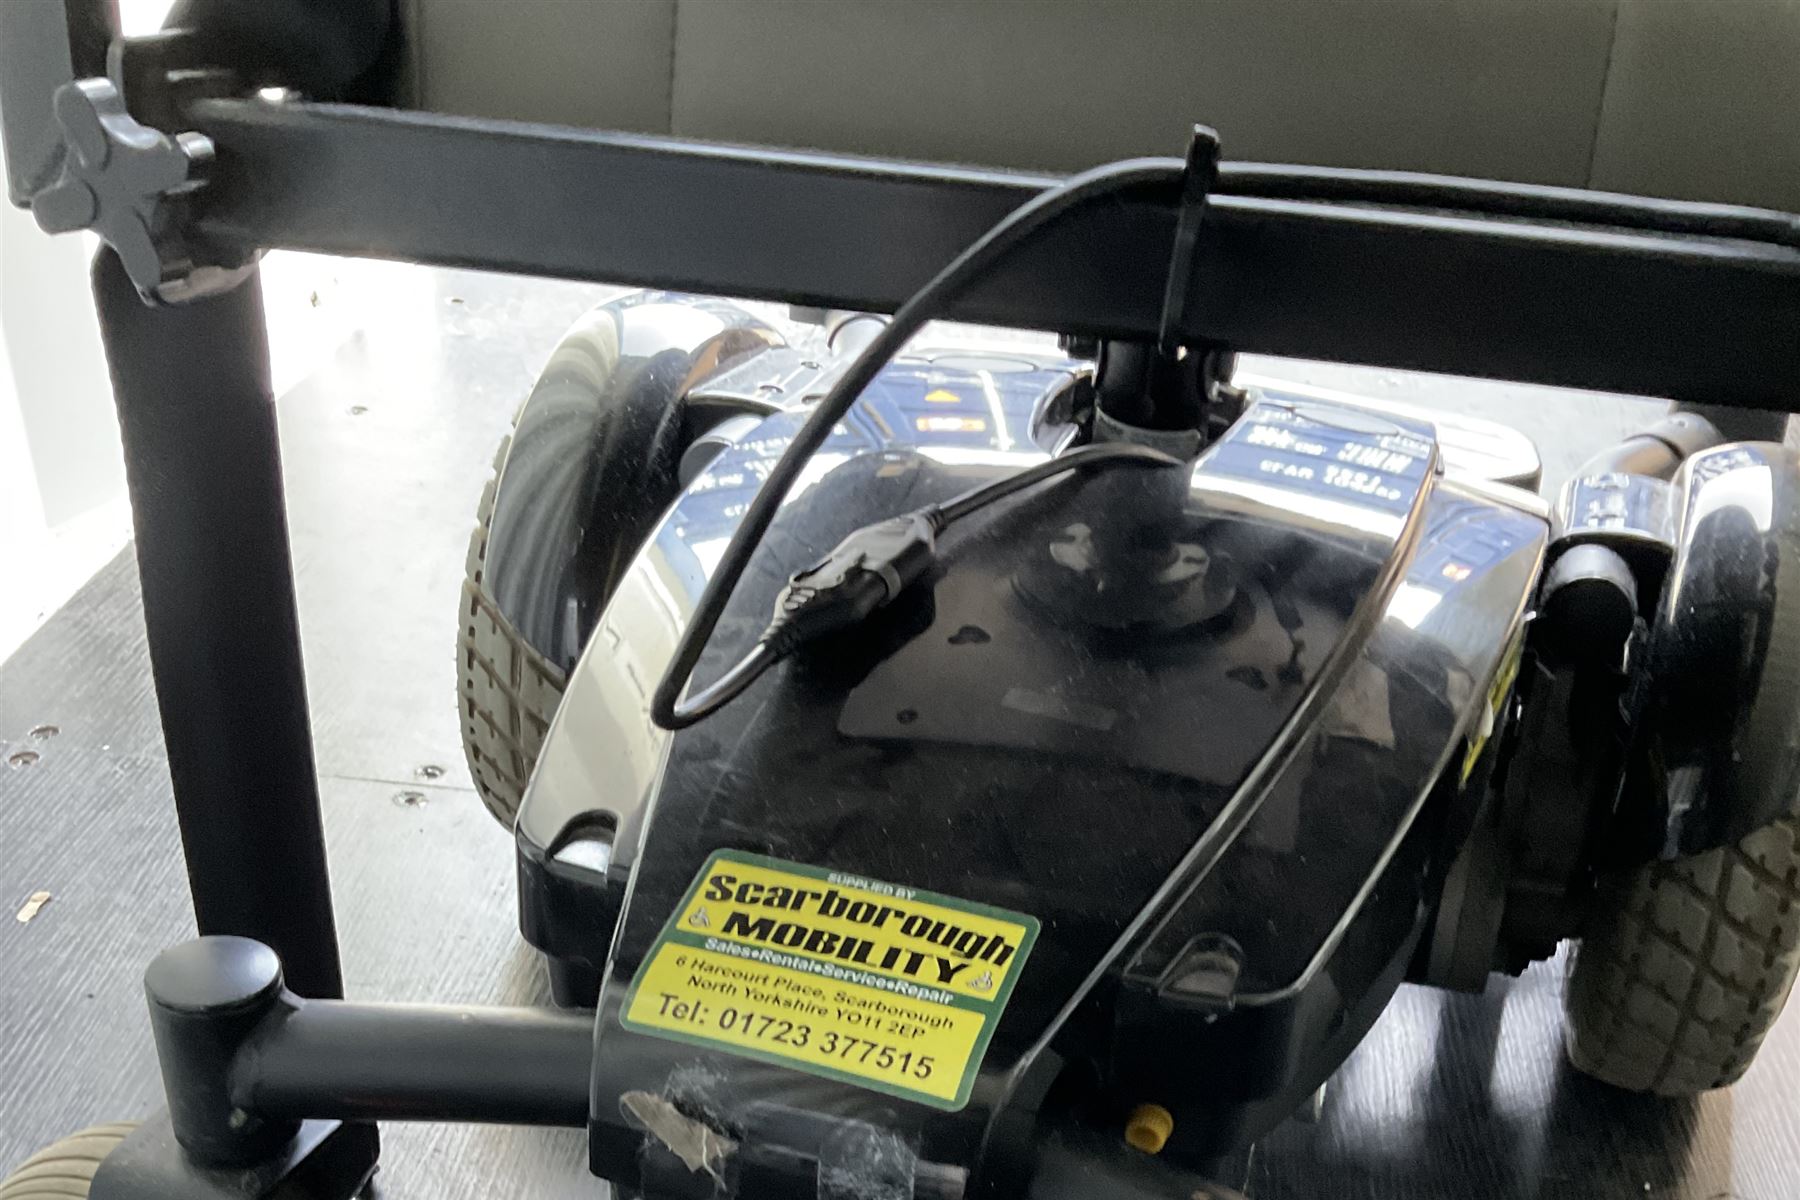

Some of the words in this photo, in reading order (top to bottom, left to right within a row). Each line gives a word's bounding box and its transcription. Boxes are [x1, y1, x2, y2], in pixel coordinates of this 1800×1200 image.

[705, 874, 1015, 967] Scarborough
[828, 872, 893, 896] SUPPLIED
[895, 887, 916, 900] BY
[721, 911, 971, 984] MOBILITY
[676, 955, 687, 967] 6
[690, 957, 769, 986] Harcourt
[773, 976, 826, 1001] Place,
[834, 991, 954, 1029] Scarborough
[687, 974, 737, 997] North
[745, 986, 828, 1016] Yorkshire
[836, 1007, 882, 1030] YO11
[887, 1020, 926, 1039] 2EP
[658, 992, 709, 1025] Tel:
[719, 1007, 811, 1047] 01723
[819, 1031, 935, 1079] 377515
